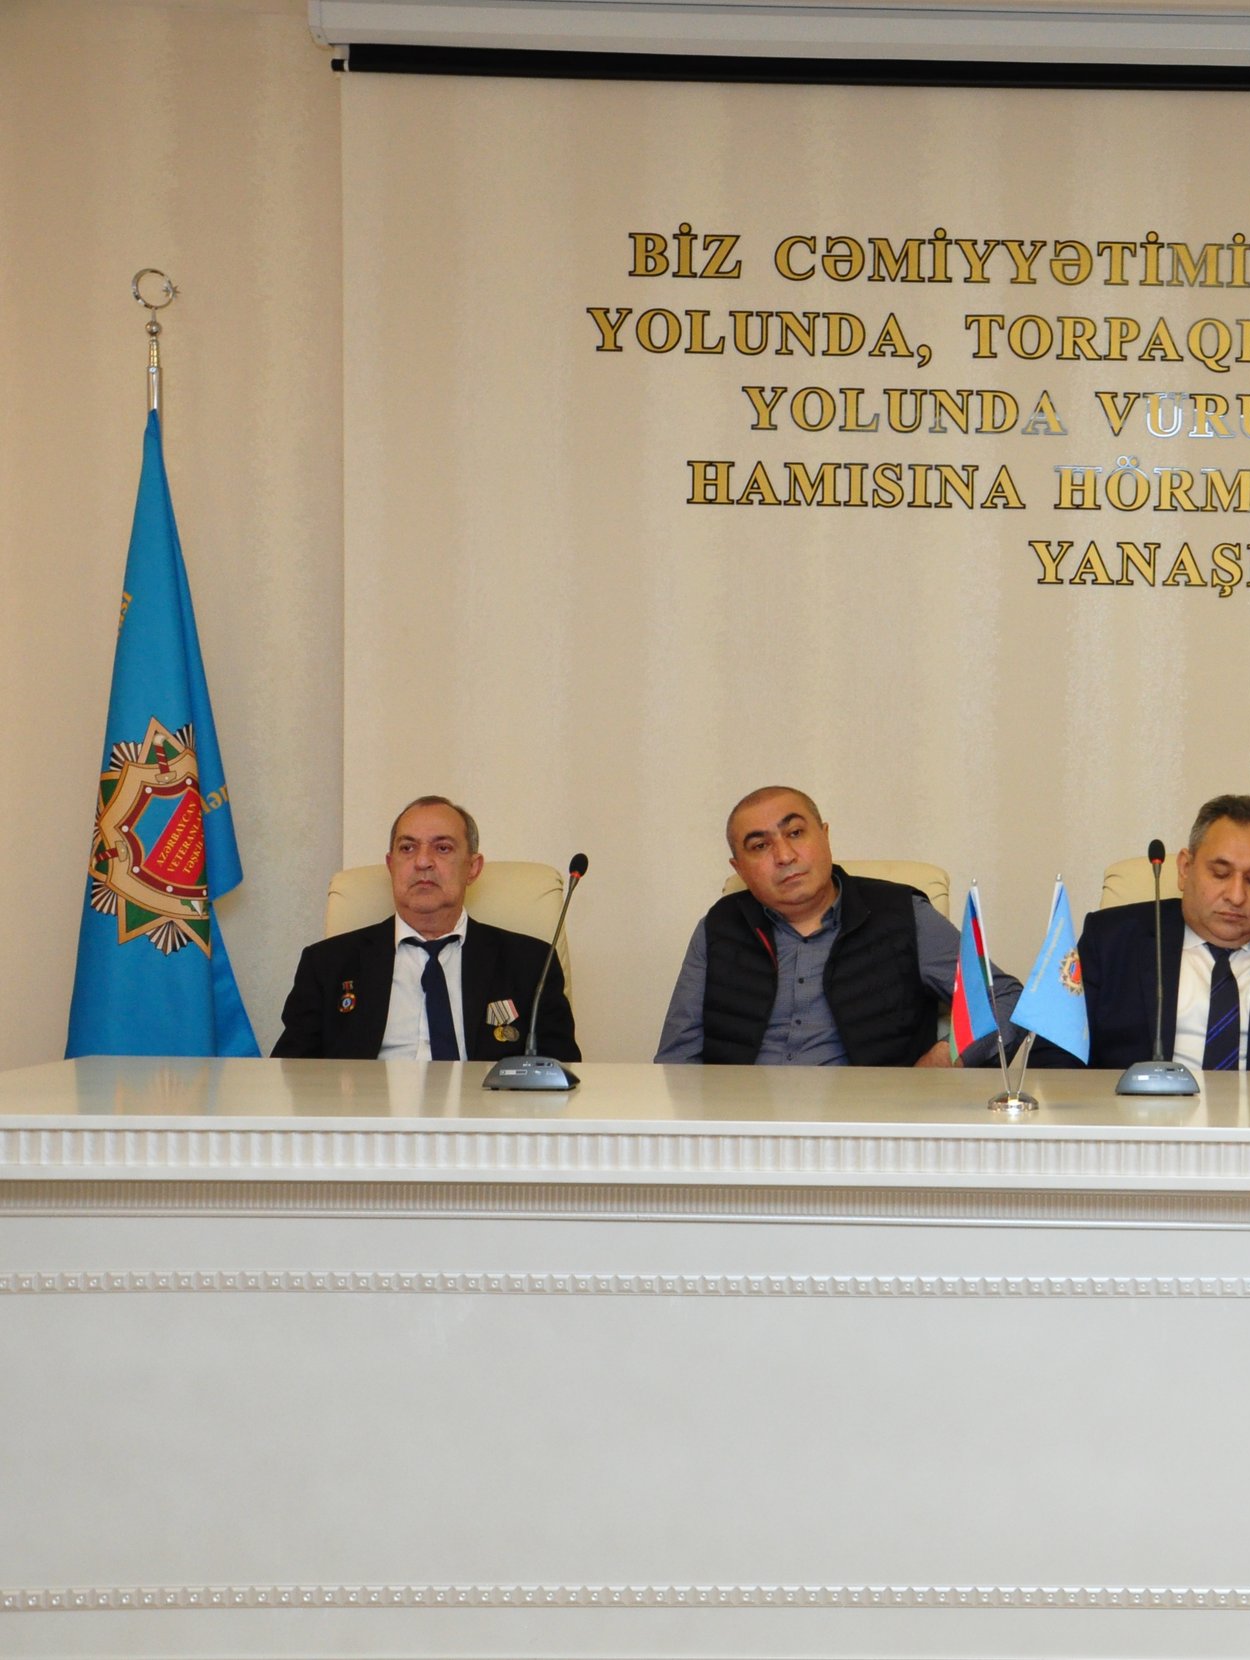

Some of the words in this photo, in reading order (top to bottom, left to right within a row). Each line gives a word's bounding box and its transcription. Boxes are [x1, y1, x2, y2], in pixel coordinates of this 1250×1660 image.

[628, 223, 742, 279] BİZ
[587, 307, 933, 368] YOLUNDA,
[742, 386, 1068, 435] YOLUNDA
[687, 461, 1026, 509] HAMISINA
